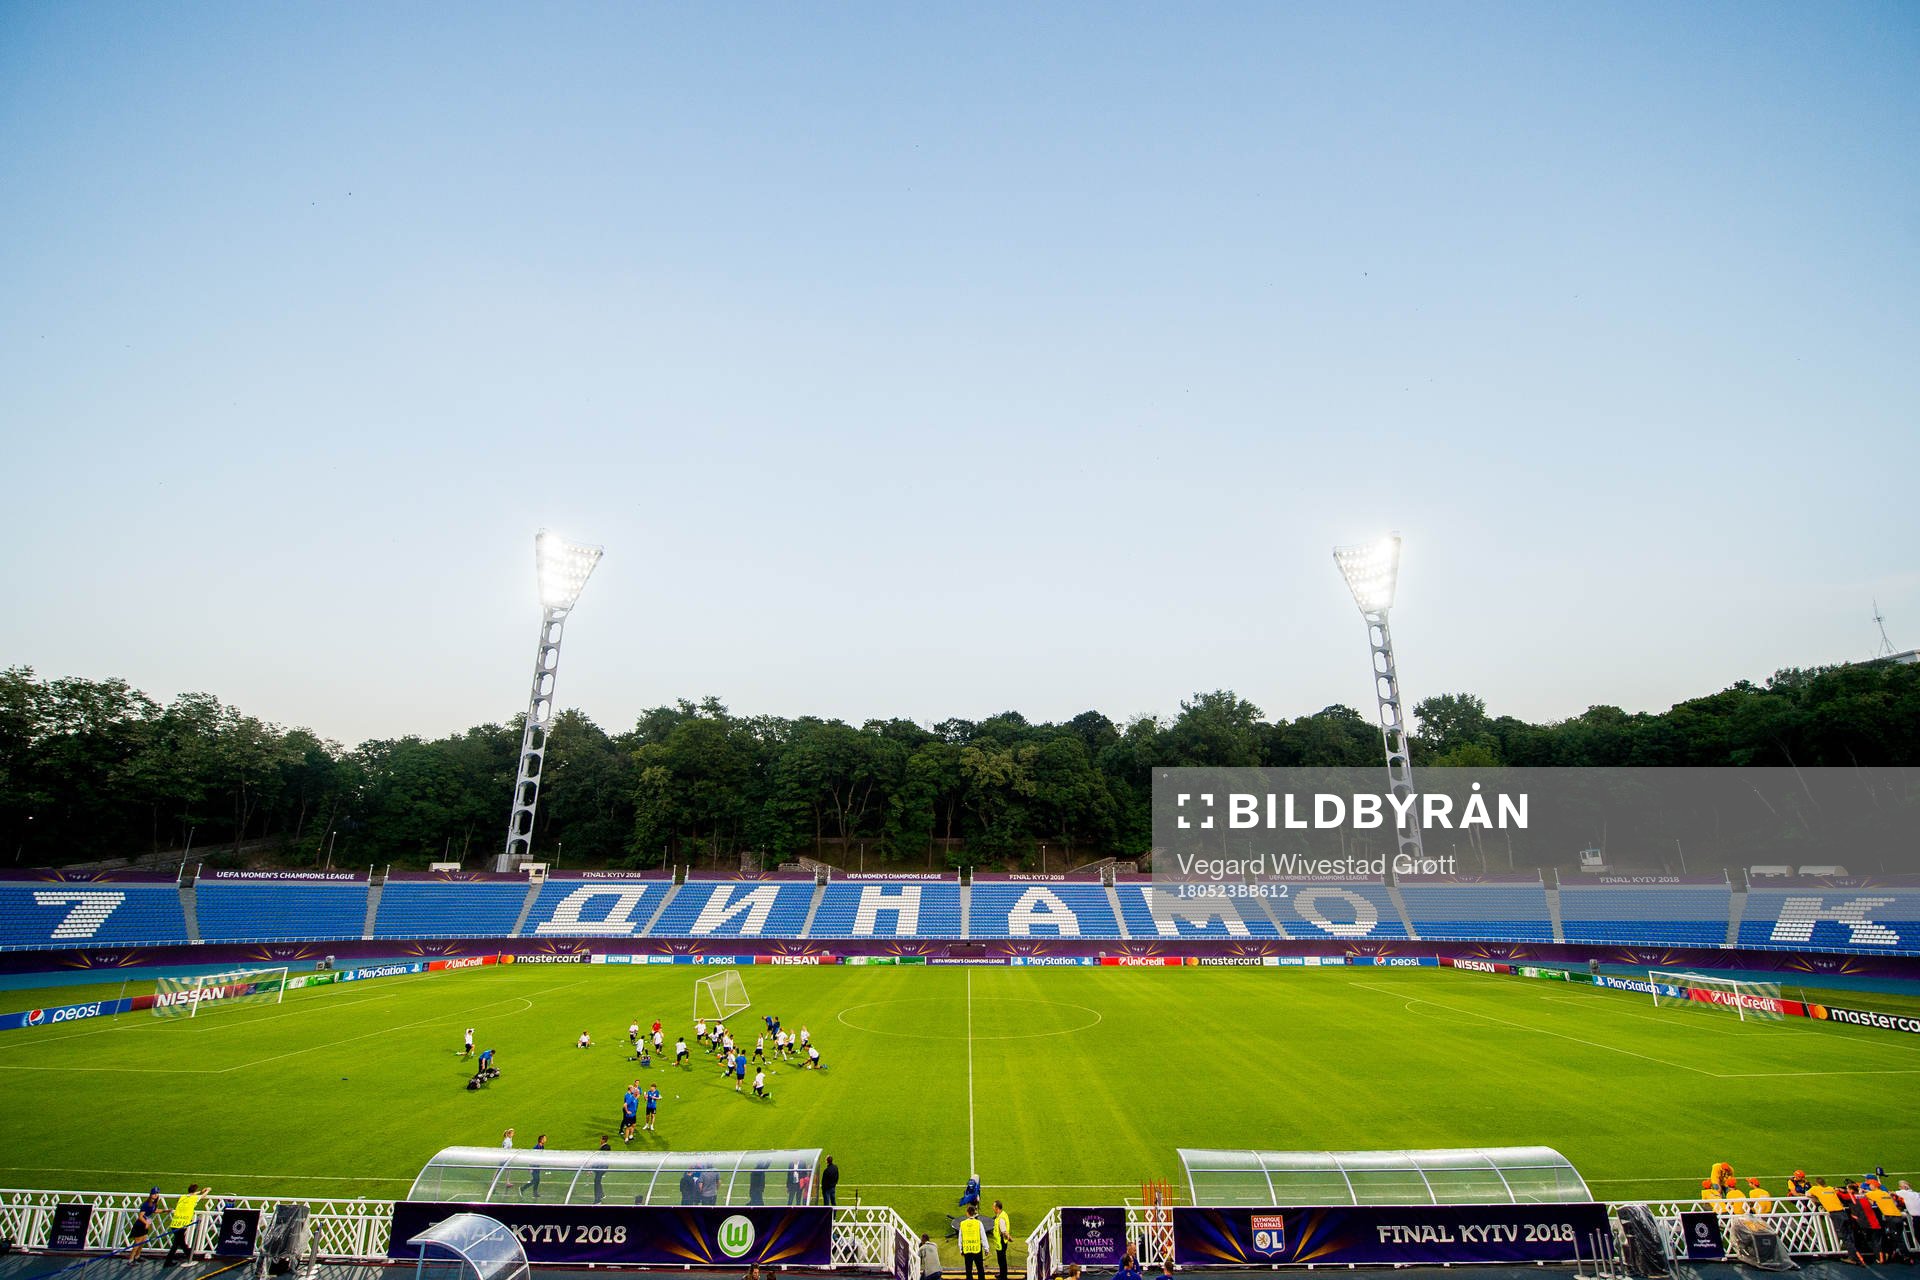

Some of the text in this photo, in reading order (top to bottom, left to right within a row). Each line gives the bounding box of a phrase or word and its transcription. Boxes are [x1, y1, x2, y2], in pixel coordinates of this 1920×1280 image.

[279, 872, 326, 880] CHAMPIONS
[452, 956, 484, 968] UniCredit
[517, 954, 581, 964] mastercard
[708, 955, 736, 965] pepsi
[771, 955, 820, 965] NISSAN
[1027, 956, 1077, 966] PlayStation
[1127, 956, 1165, 966] UniCredit
[1201, 956, 1261, 966] mastercard
[1390, 957, 1421, 966] pepsi
[1453, 959, 1496, 973] NISSAN
[357, 965, 406, 979] PlayStation
[156, 987, 225, 1007] NISSAN
[1722, 992, 1777, 1012] UnCredit
[52, 1001, 102, 1023] pepsi
[511, 1224, 571, 1243] KYIV
[575, 1225, 627, 1244] 2018
[1376, 1223, 1575, 1243] FINAL KYIV 2018
[1075, 1238, 1114, 1246] WOMEN'S
[1255, 1231, 1282, 1249] OL
